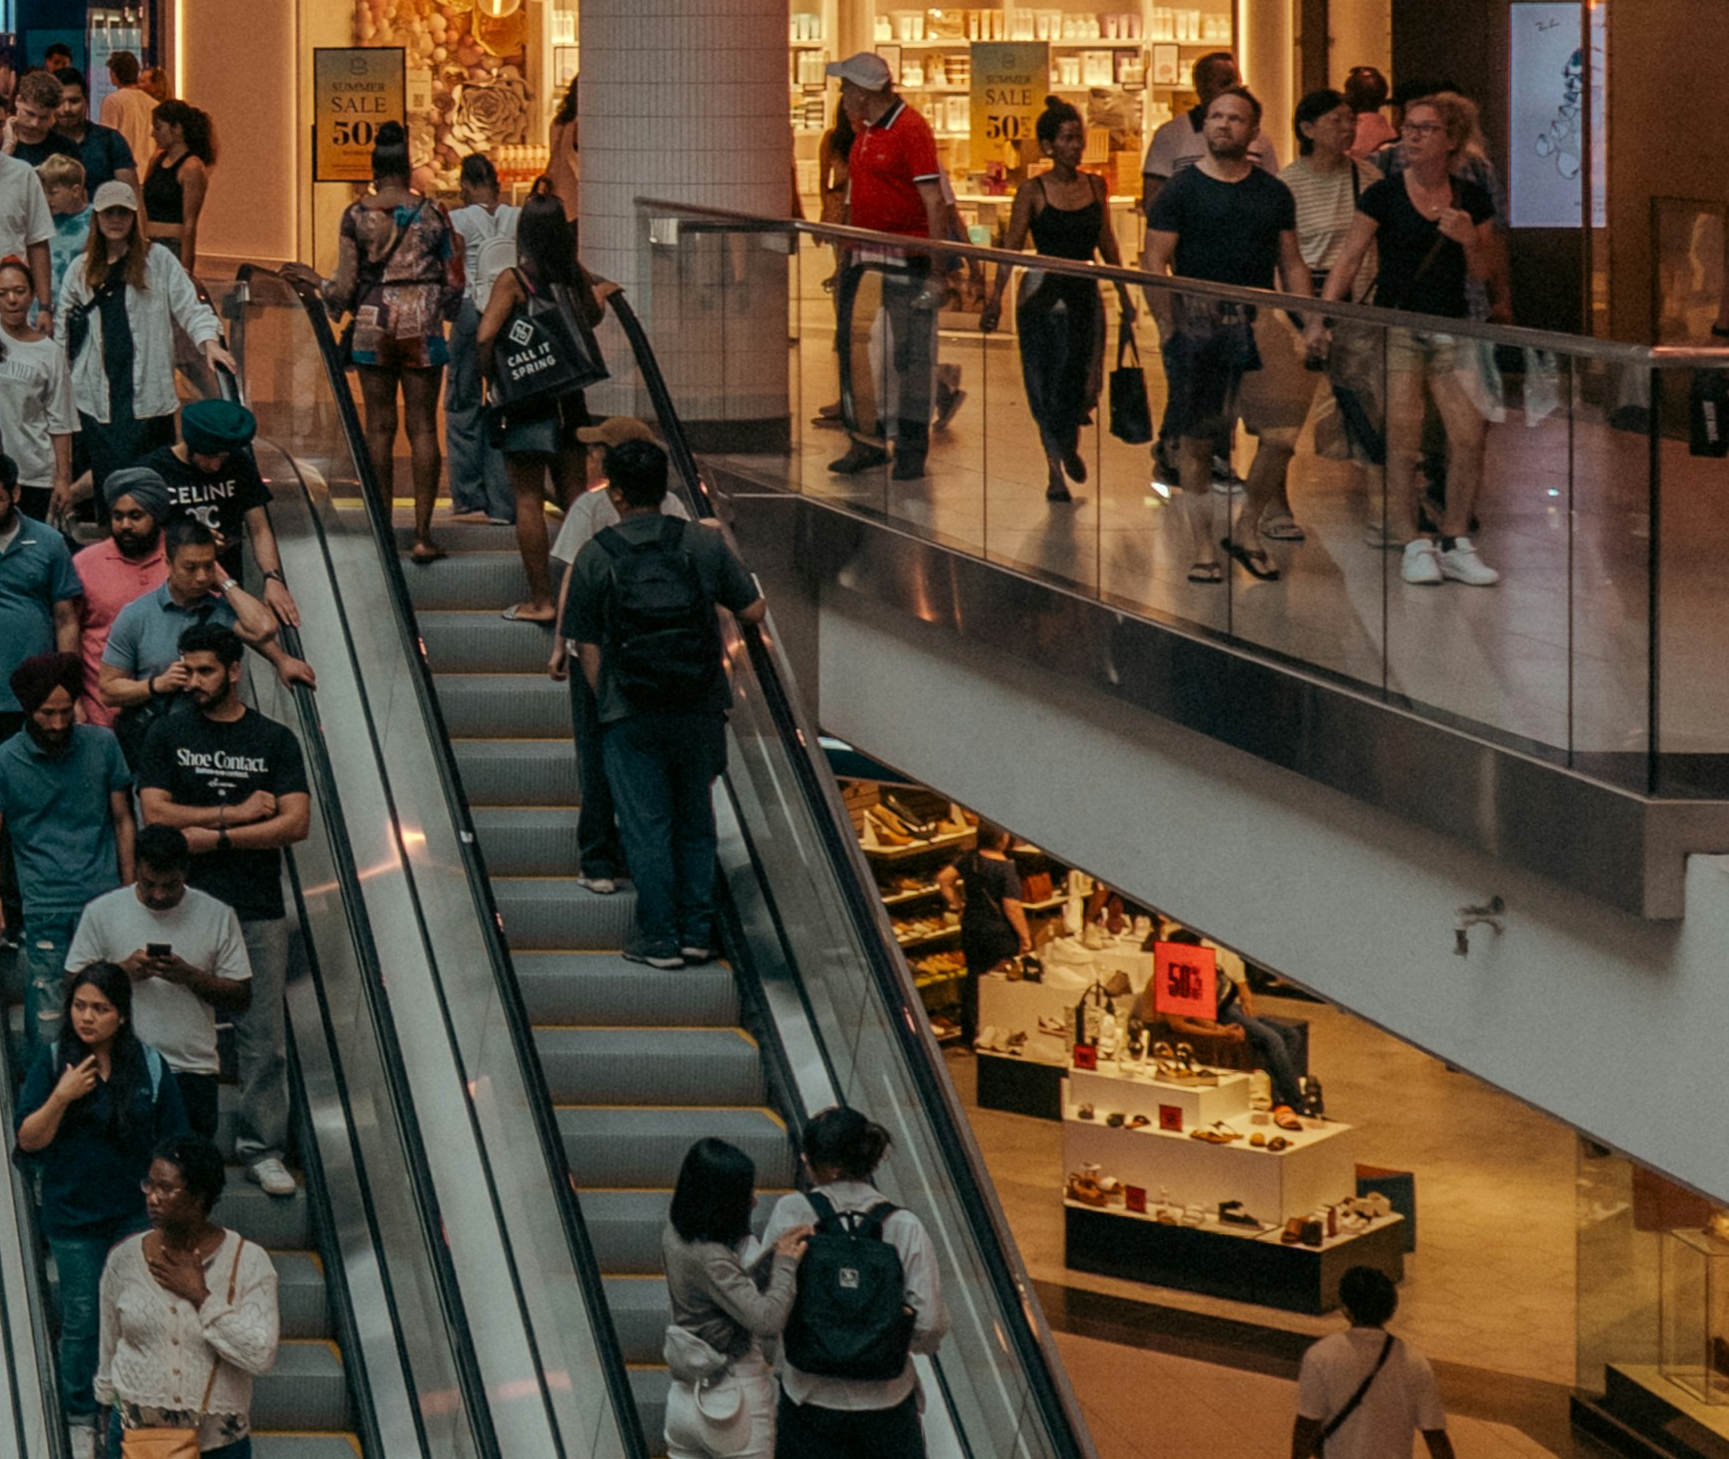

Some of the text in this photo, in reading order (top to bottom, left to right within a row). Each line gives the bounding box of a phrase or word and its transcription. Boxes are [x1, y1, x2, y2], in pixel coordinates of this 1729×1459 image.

[332, 82, 385, 93] SUMMER
[985, 88, 1032, 107] SALE
[331, 96, 387, 114] SALE
[507, 341, 552, 368] CALL IT
[511, 355, 557, 381] SPRING
[176, 747, 213, 768] Shoe
[213, 749, 270, 773] Contact.
